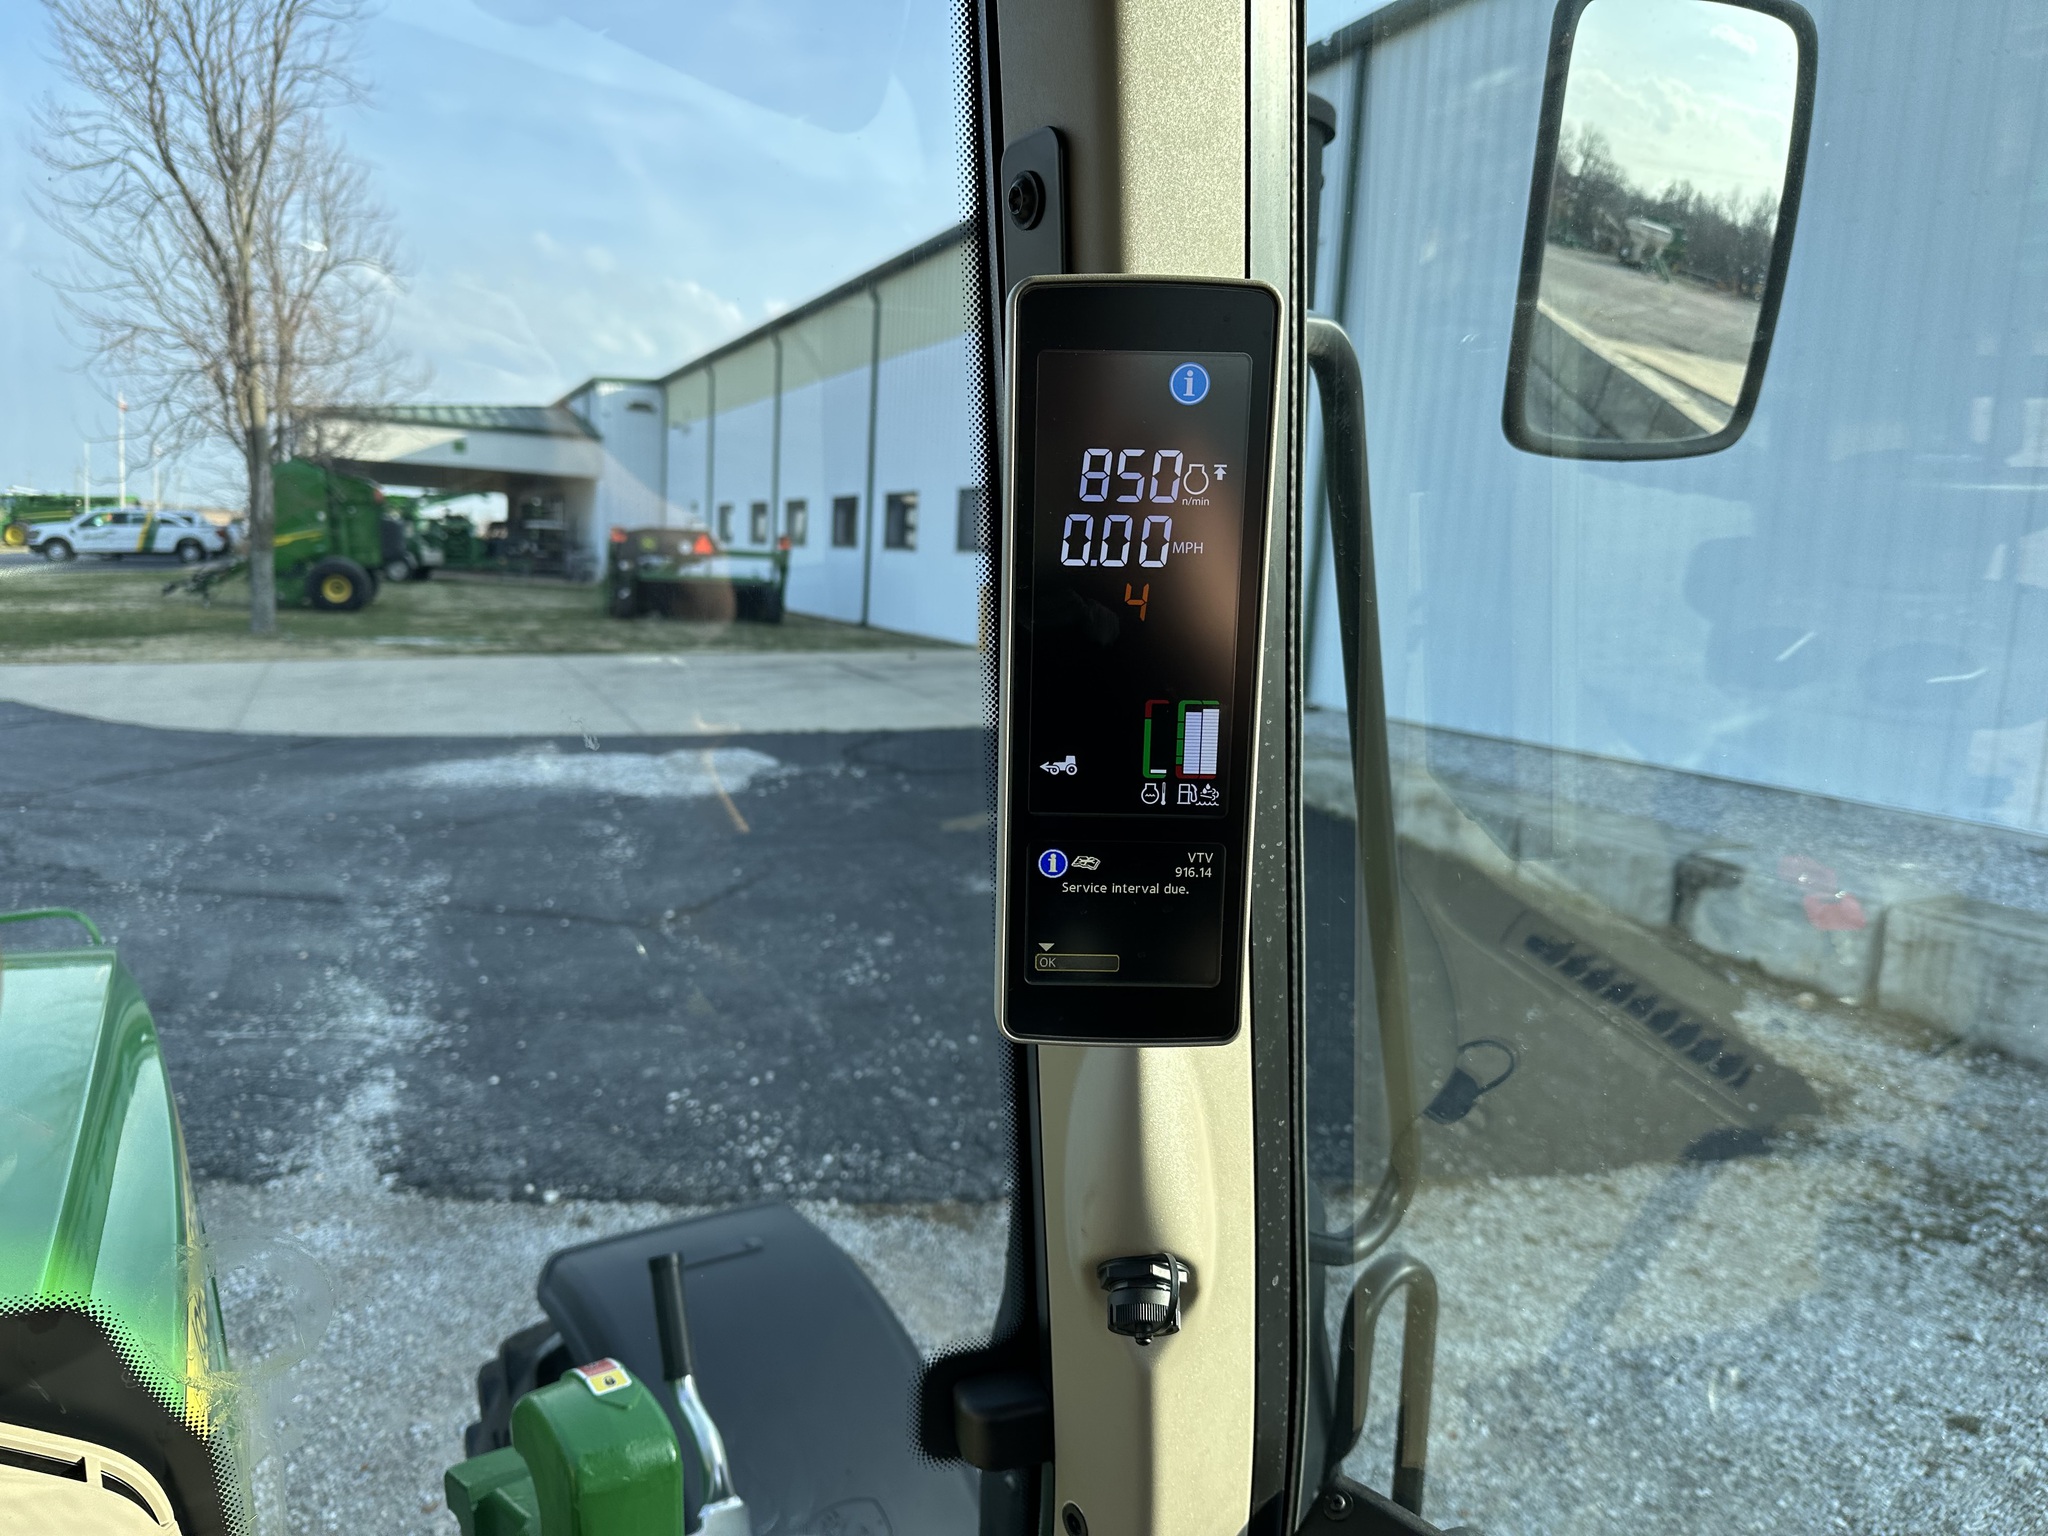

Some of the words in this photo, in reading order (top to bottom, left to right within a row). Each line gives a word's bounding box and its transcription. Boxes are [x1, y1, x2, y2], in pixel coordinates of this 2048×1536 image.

[1079, 448, 1183, 503] 850
[1182, 497, 1210, 506] n/min
[1060, 514, 1172, 568] 0.00
[1172, 542, 1204, 554] MPH
[1124, 583, 1149, 621] 4
[1187, 852, 1214, 864] VTV
[1175, 867, 1212, 878] 916.14
[1062, 882, 1107, 894] Service
[1111, 883, 1160, 895] interval
[1164, 883, 1190, 895] due.
[1039, 958, 1057, 967] OK
